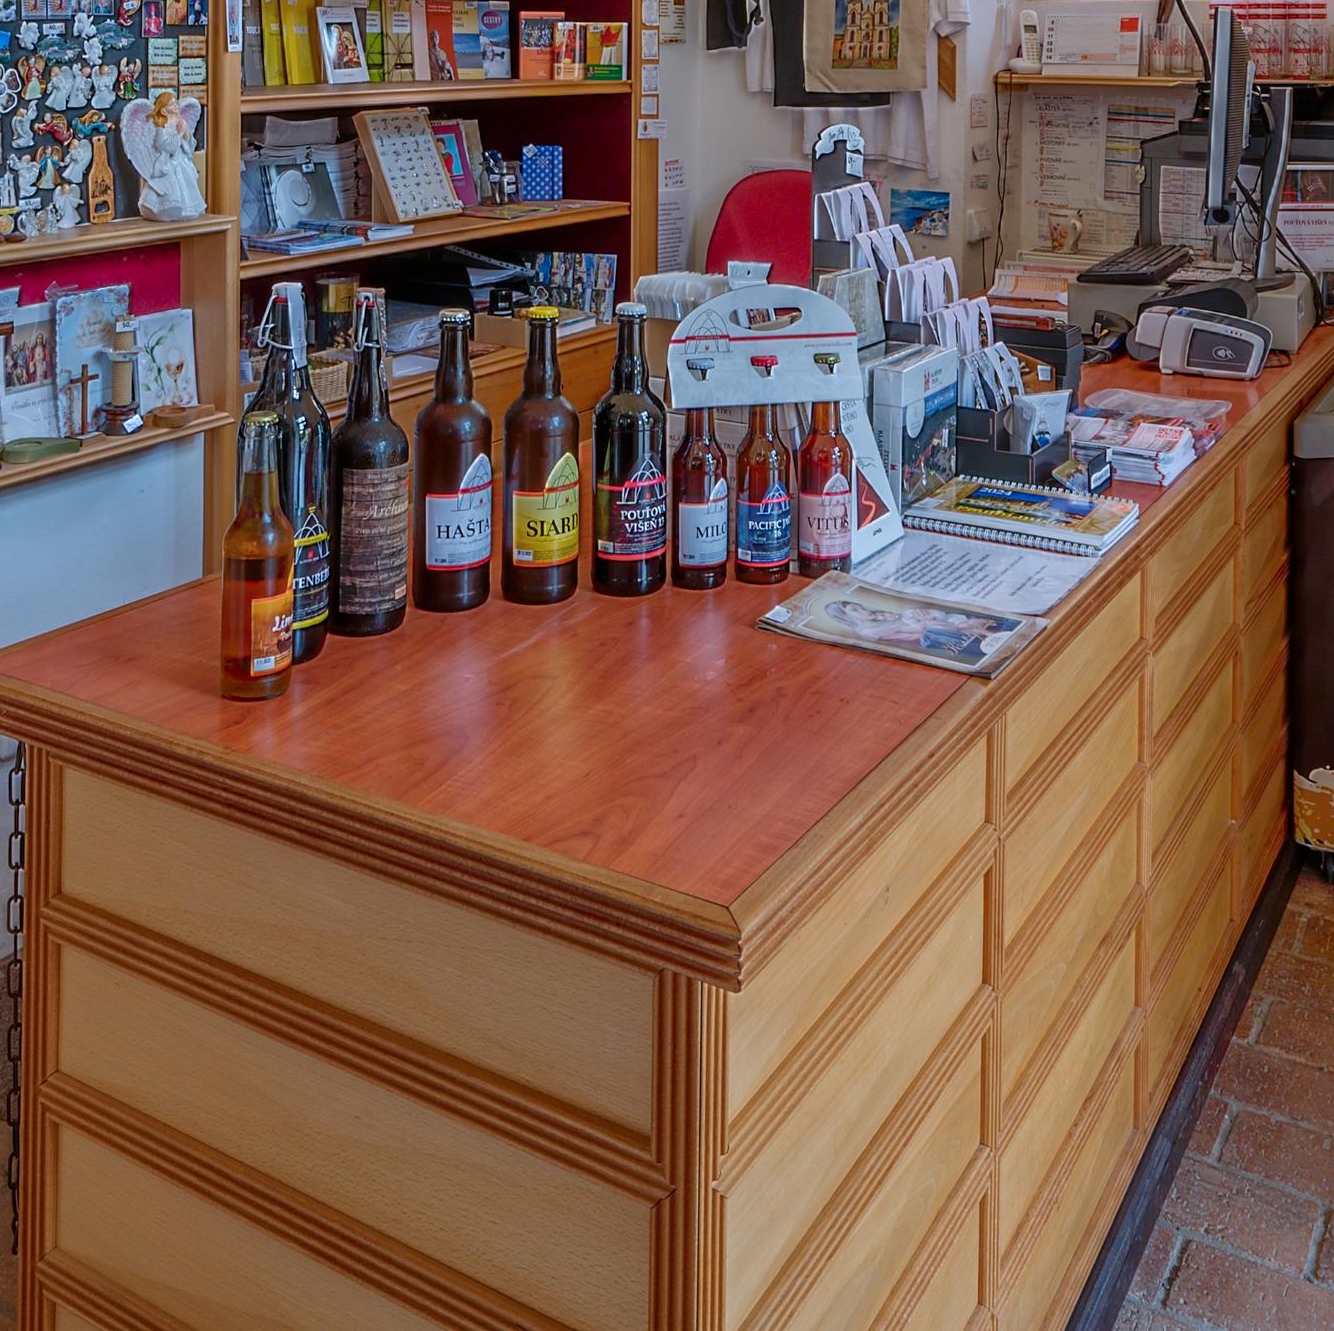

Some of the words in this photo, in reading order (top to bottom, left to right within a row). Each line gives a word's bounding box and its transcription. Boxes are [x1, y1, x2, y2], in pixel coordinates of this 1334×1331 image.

[979, 486, 1013, 498] 2024
[436, 514, 491, 542] HAŠTA
[526, 512, 579, 538] SIARD
[625, 517, 658, 534] VIŠEŇ
[748, 518, 782, 531] PACIFIC
[806, 516, 850, 530] VITUS
